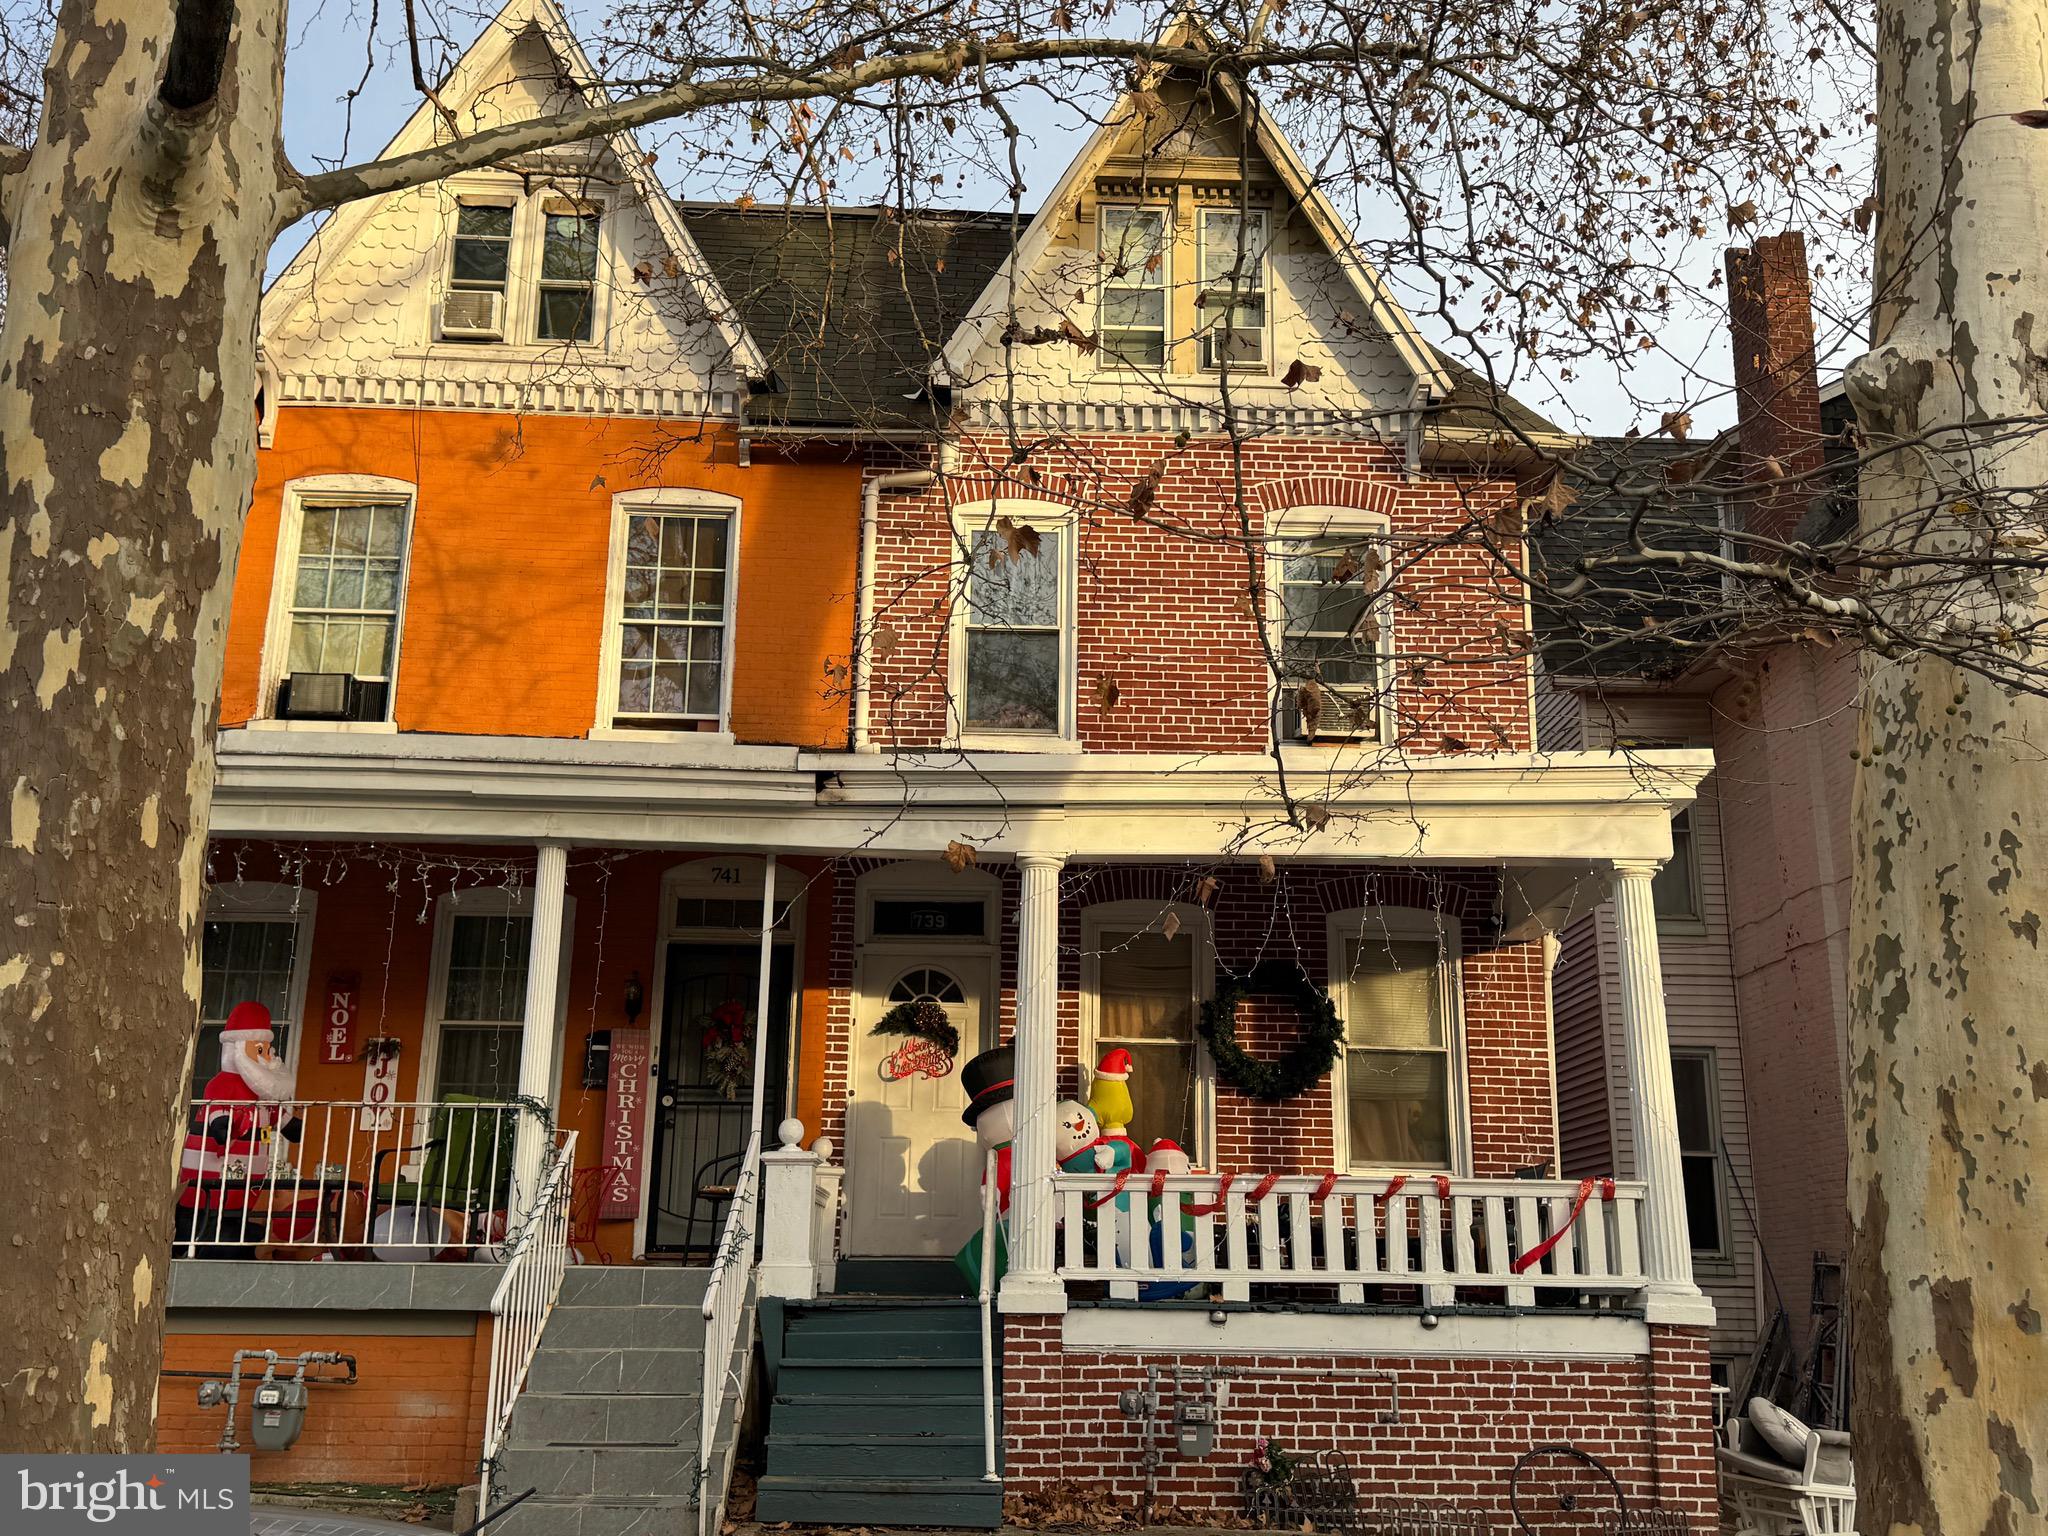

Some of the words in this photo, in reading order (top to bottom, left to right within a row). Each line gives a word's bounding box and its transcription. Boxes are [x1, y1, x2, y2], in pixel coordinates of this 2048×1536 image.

[711, 867, 741, 885] 741
[912, 914, 945, 929] 739
[328, 992, 351, 1061] NOEL
[612, 1053, 646, 1066] Merry
[370, 1057, 390, 1127] JOY
[611, 1063, 638, 1203] CHRISTMAS
